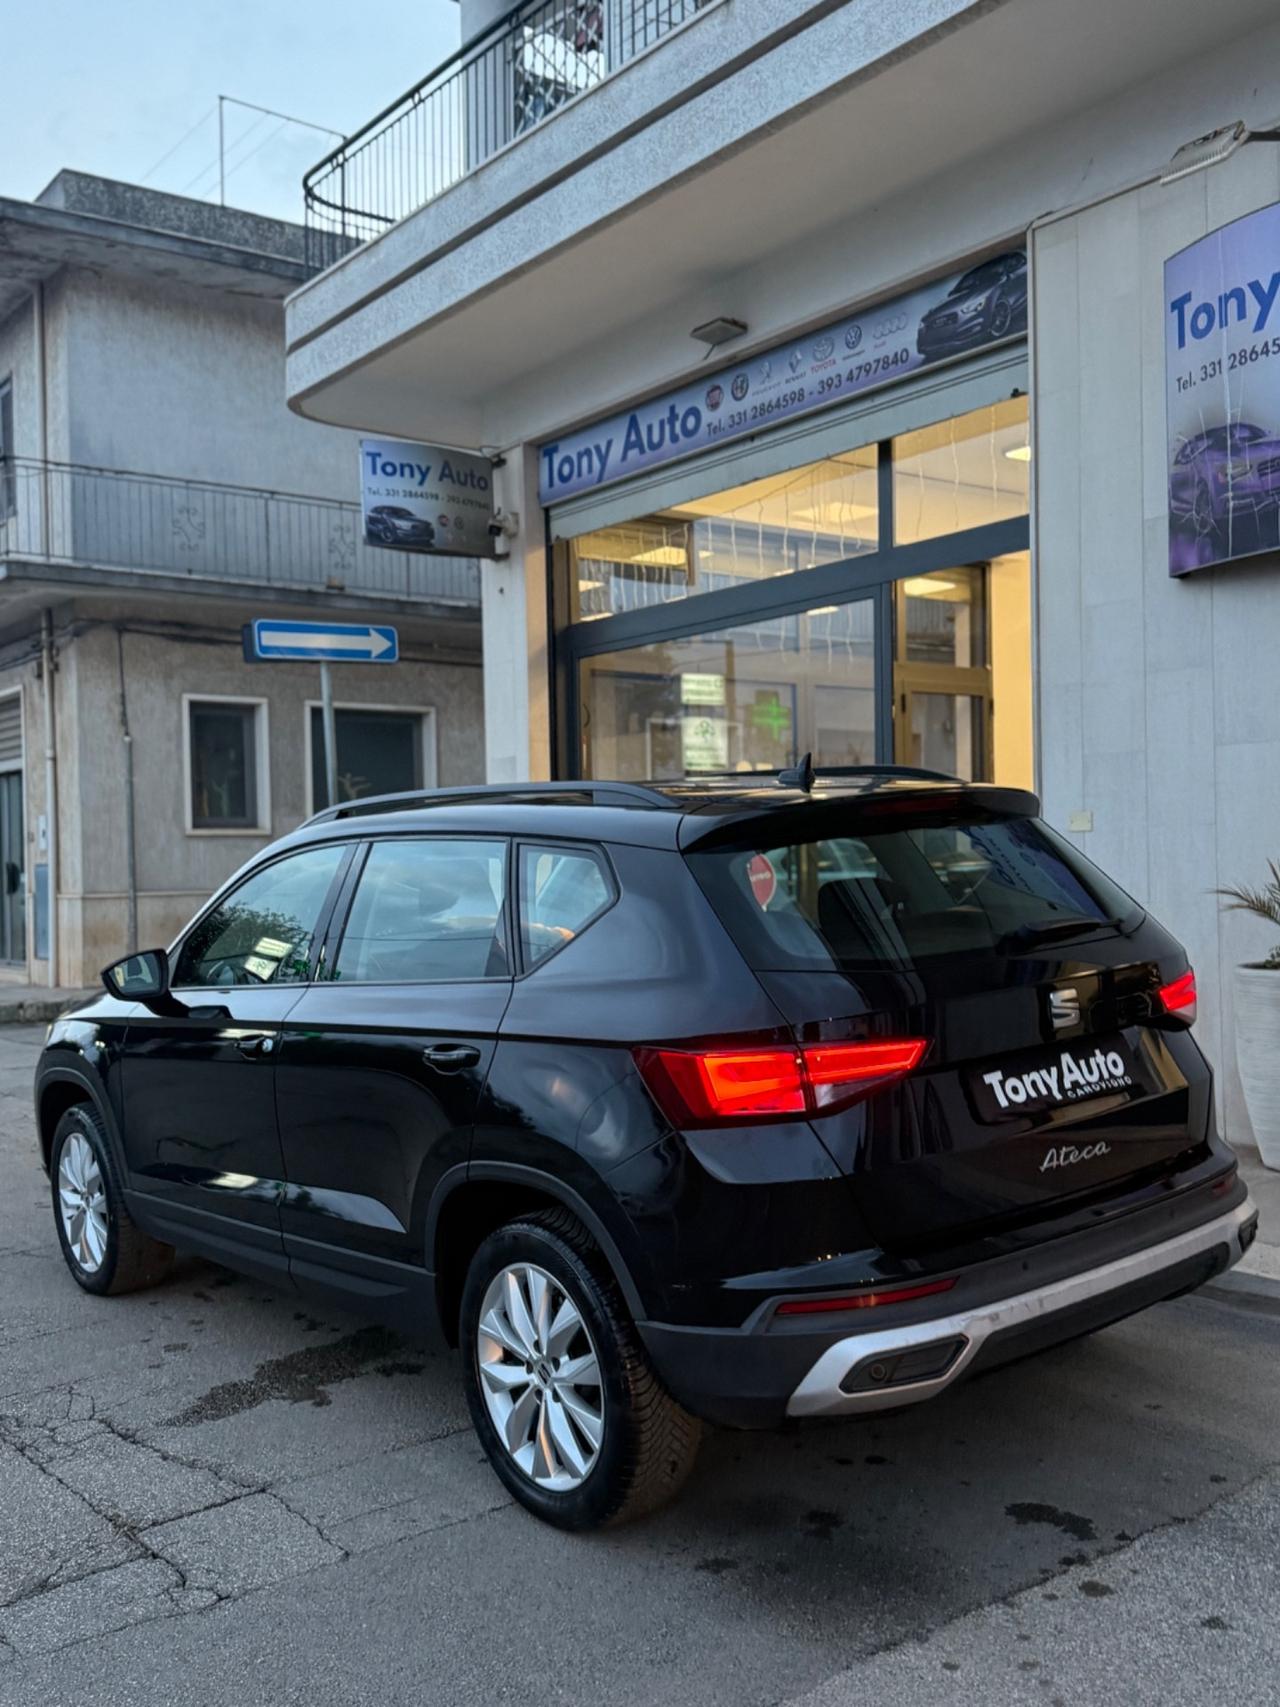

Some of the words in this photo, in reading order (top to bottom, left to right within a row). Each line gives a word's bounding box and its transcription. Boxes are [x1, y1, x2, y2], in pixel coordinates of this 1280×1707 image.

[1170, 271, 1280, 349] Tony
[706, 418, 726, 437] Tel.
[729, 410, 747, 429] 331
[751, 387, 805, 421] 2864598
[818, 374, 842, 395] 393
[846, 348, 910, 383] 4797840
[1176, 371, 1196, 393] Tel.
[1200, 359, 1222, 383] 331
[1228, 337, 1280, 371] 28645
[366, 452, 432, 486] Tony
[438, 459, 489, 491] Auto
[543, 438, 613, 489] Tony
[621, 404, 702, 463] Auto
[1039, 1141, 1112, 1173] Ateca
